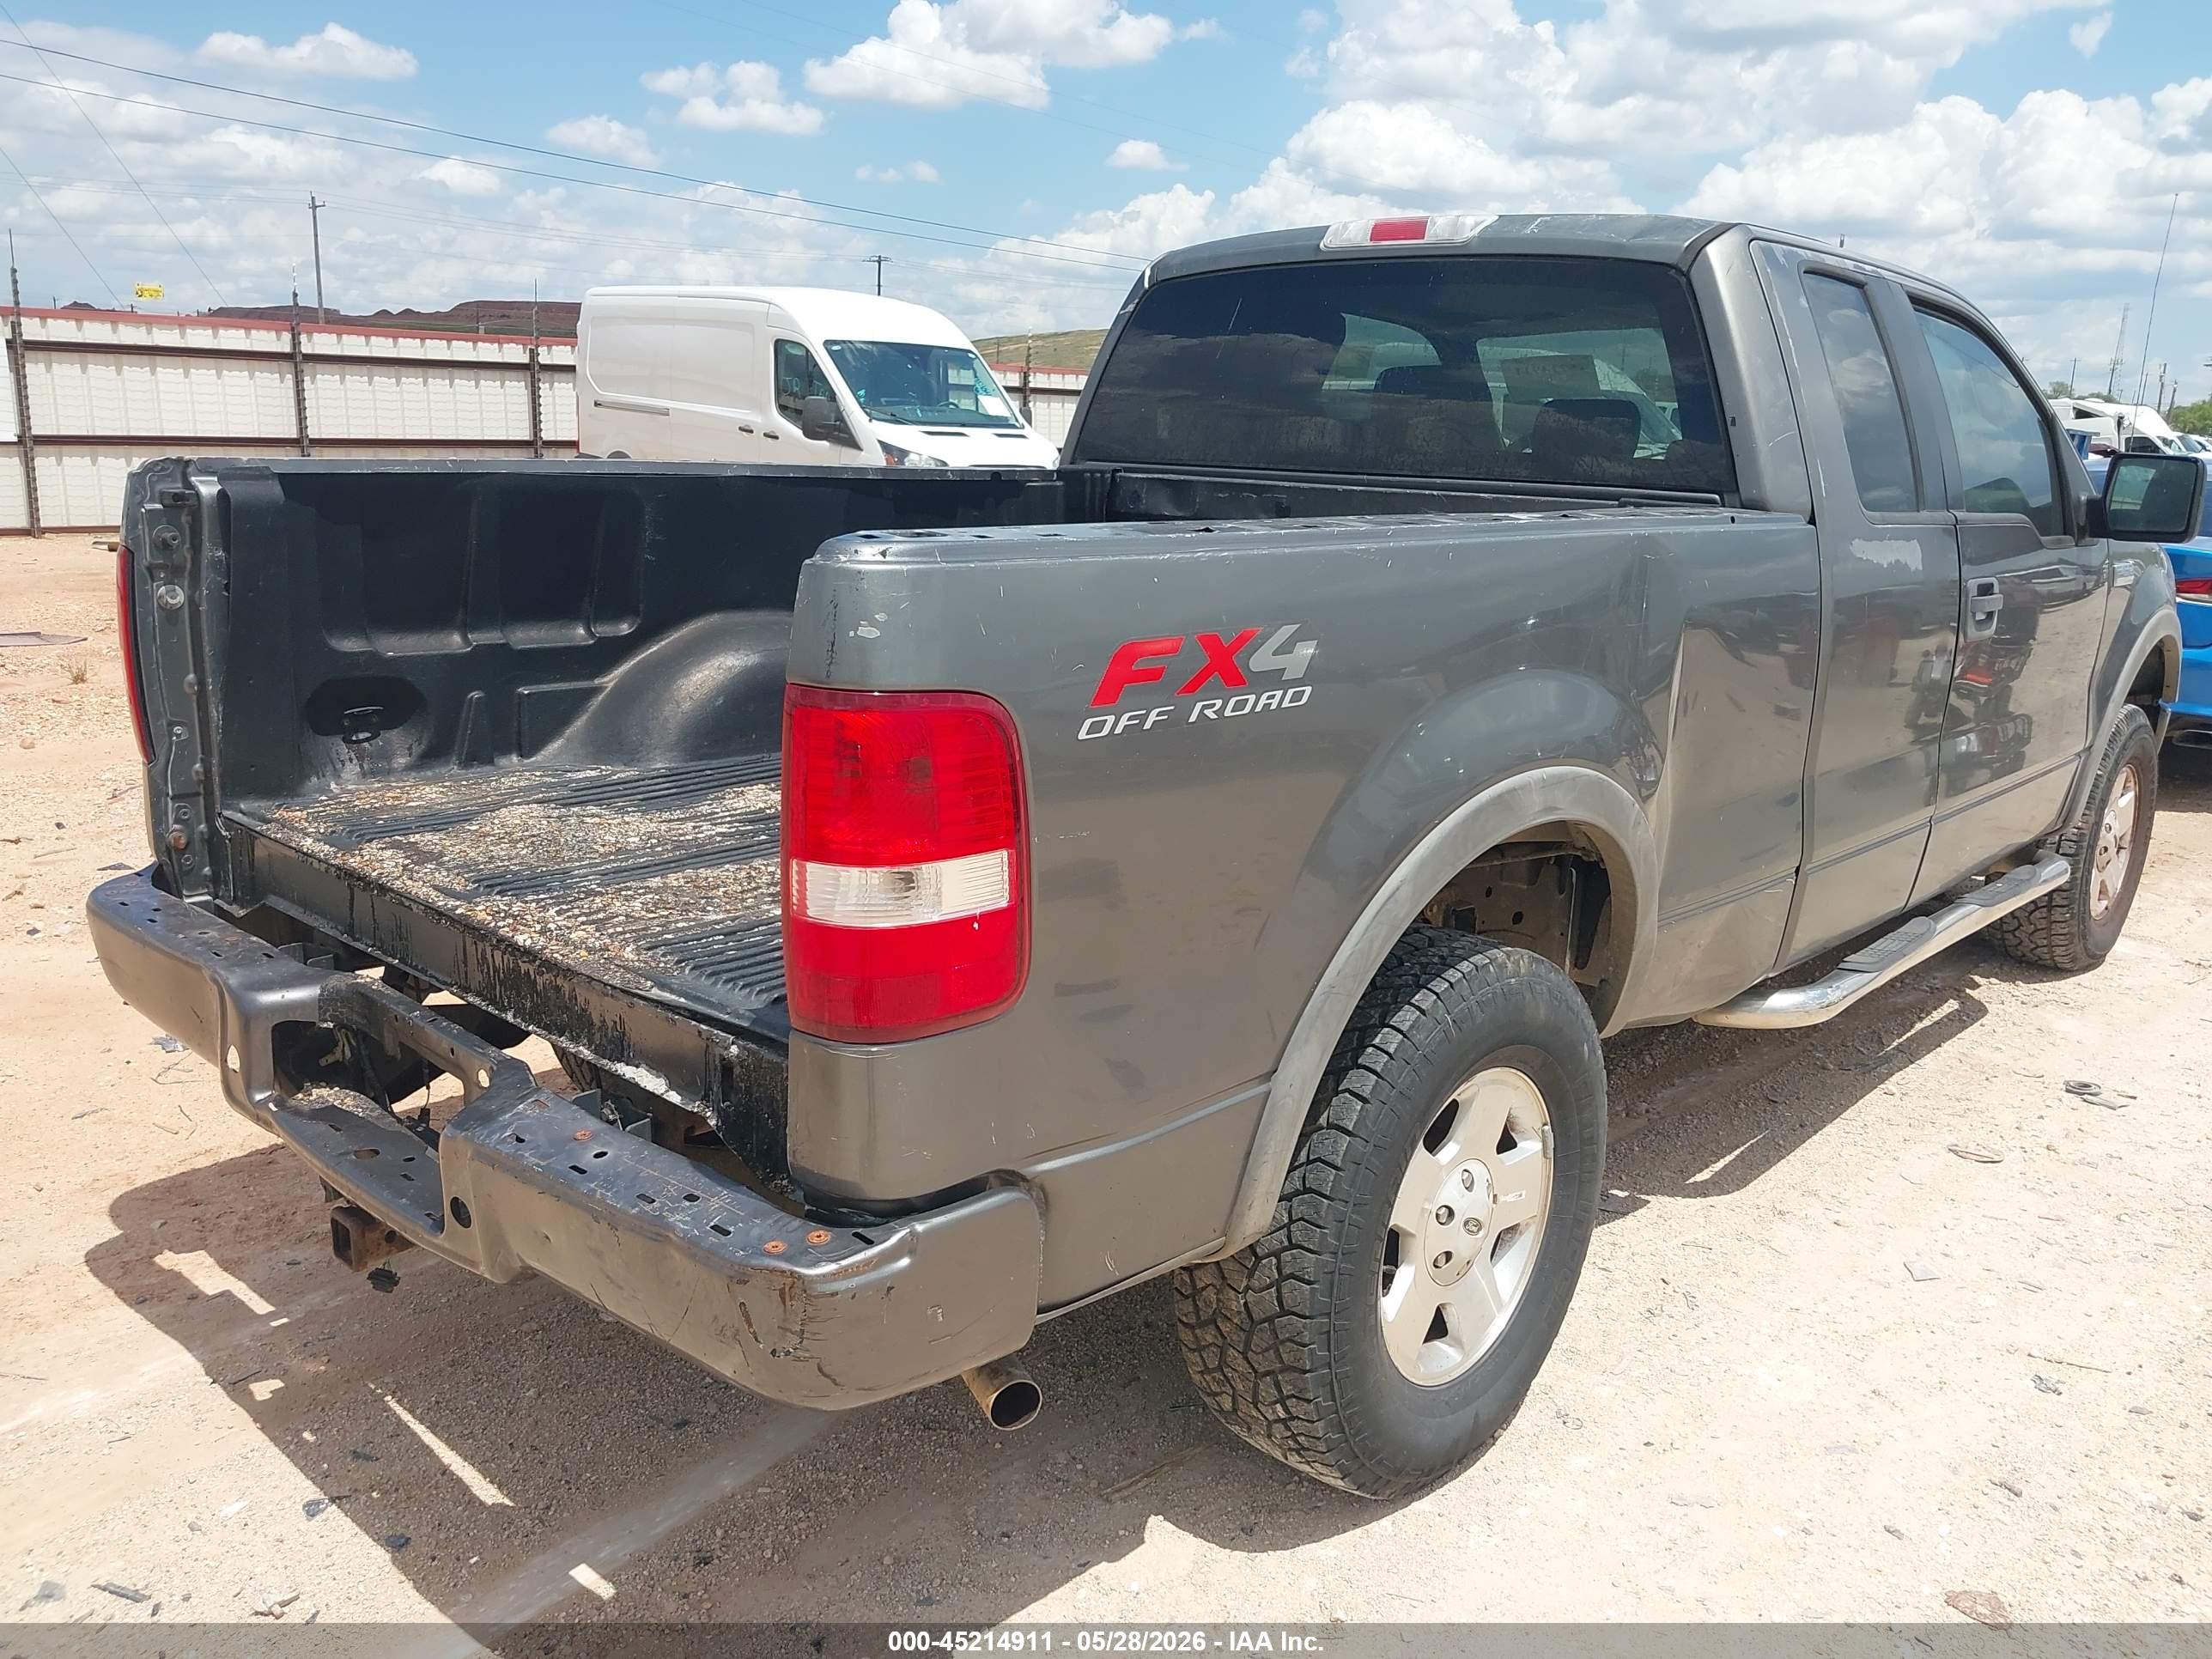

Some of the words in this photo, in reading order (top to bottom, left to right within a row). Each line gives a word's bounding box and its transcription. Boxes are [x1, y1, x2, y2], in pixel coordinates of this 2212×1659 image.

[1089, 623, 1319, 708] FX4
[1077, 705, 1176, 740] OFF
[1188, 685, 1313, 723] ROAD
